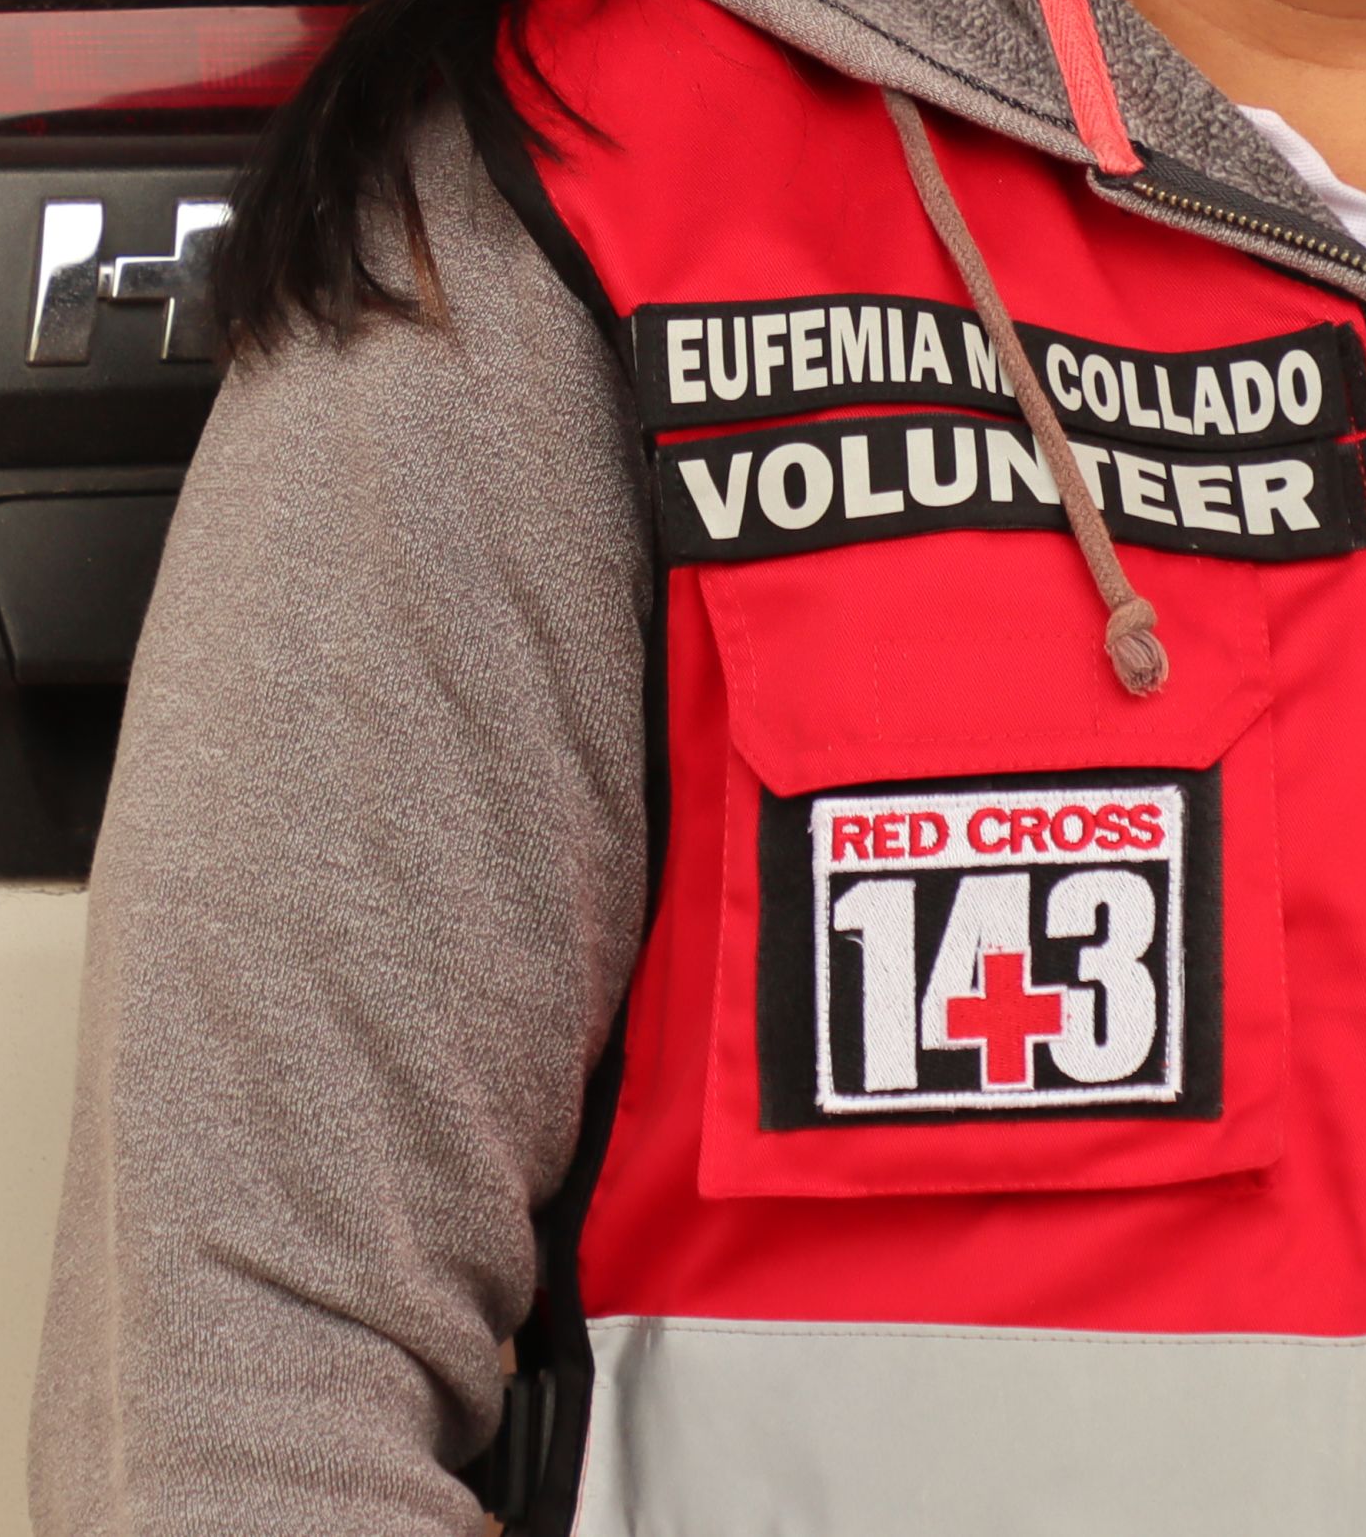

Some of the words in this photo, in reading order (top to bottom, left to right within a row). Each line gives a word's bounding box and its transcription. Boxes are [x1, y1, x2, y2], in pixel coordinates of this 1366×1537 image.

[666, 306, 953, 405] EUFEMIA
[1045, 342, 1324, 436] COLLADO
[677, 426, 1322, 541] VOLUNTEER
[831, 811, 950, 862] RED
[966, 803, 1166, 854] CROSS
[833, 869, 1157, 1092] 143
